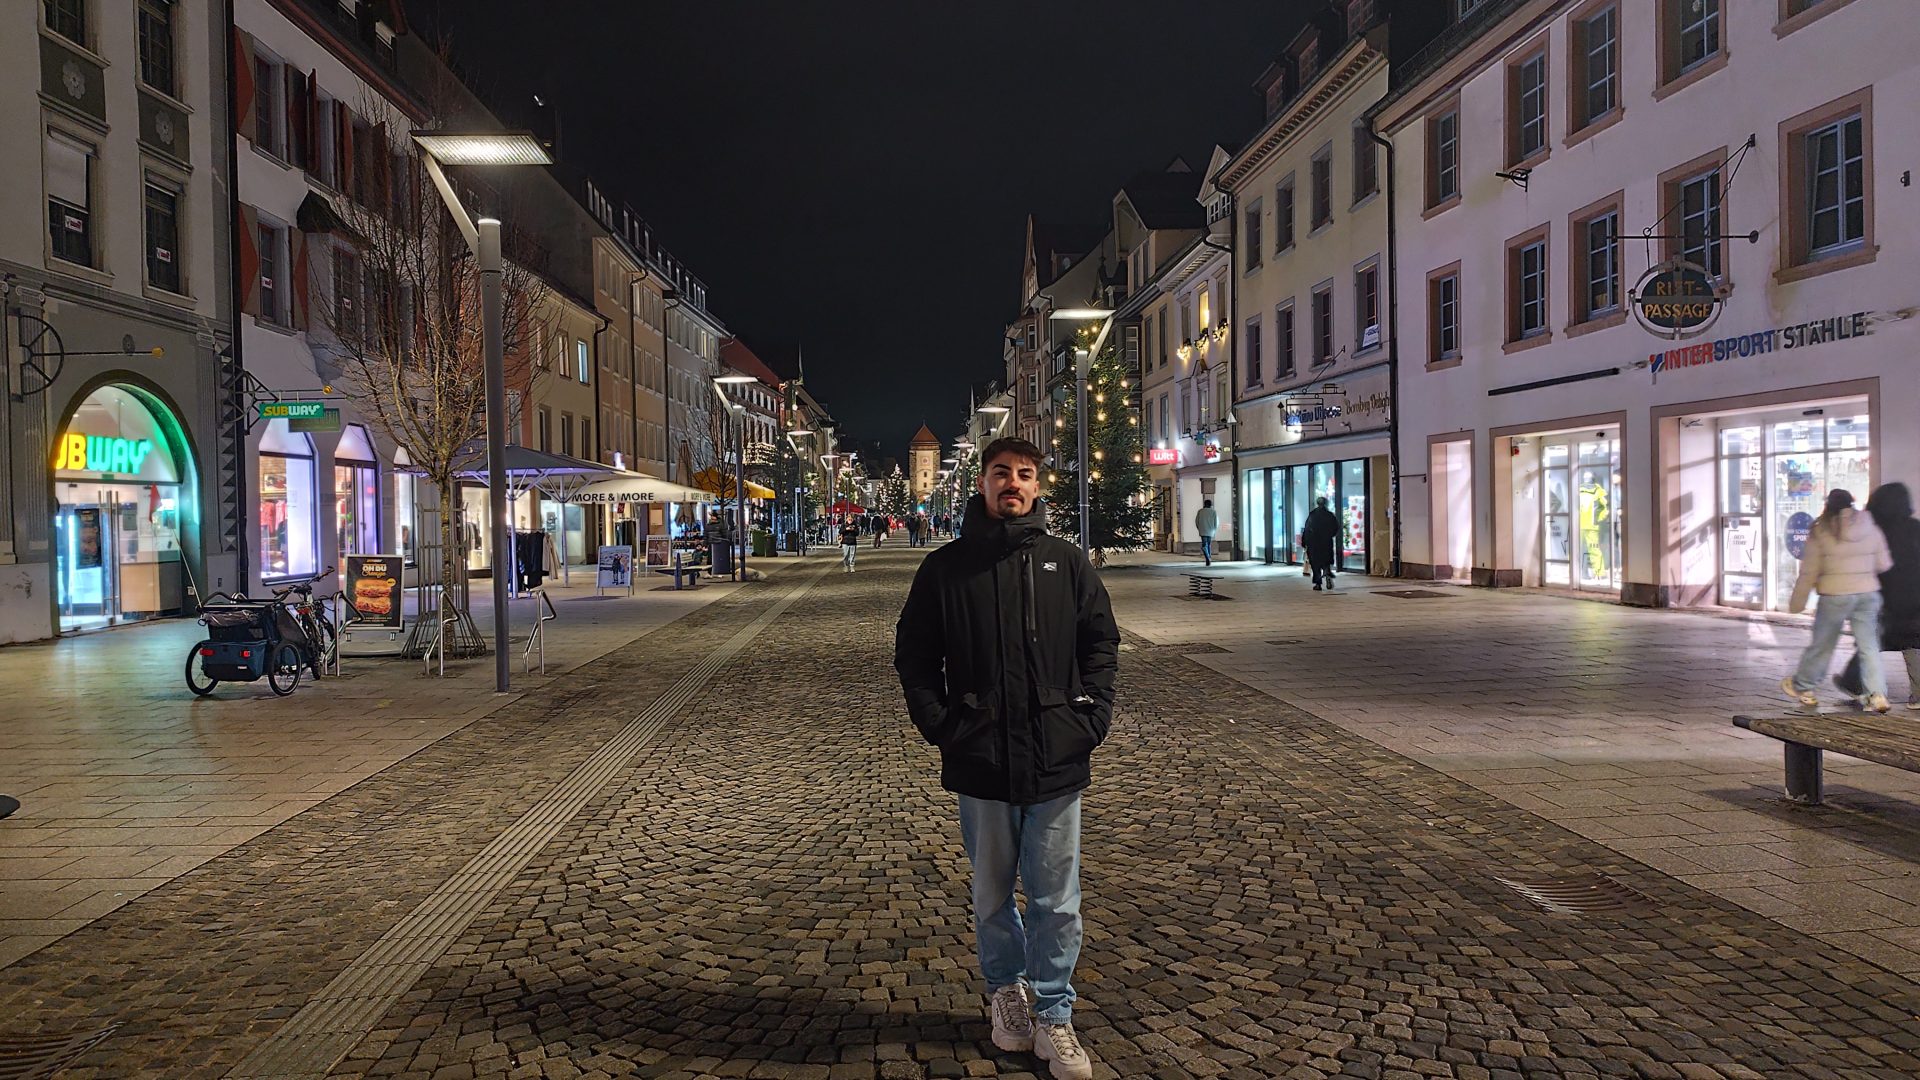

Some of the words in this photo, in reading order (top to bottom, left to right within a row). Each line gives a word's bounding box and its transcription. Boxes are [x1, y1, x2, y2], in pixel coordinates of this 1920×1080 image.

[1644, 303, 1711, 318] PASSAGE
[1664, 329, 1776, 371] INTERSPORT
[1783, 311, 1865, 349] STÄHLE
[263, 404, 320, 416] SUBWAY
[572, 493, 605, 502] MORE
[607, 493, 615, 502] &
[621, 492, 654, 501] MORE
